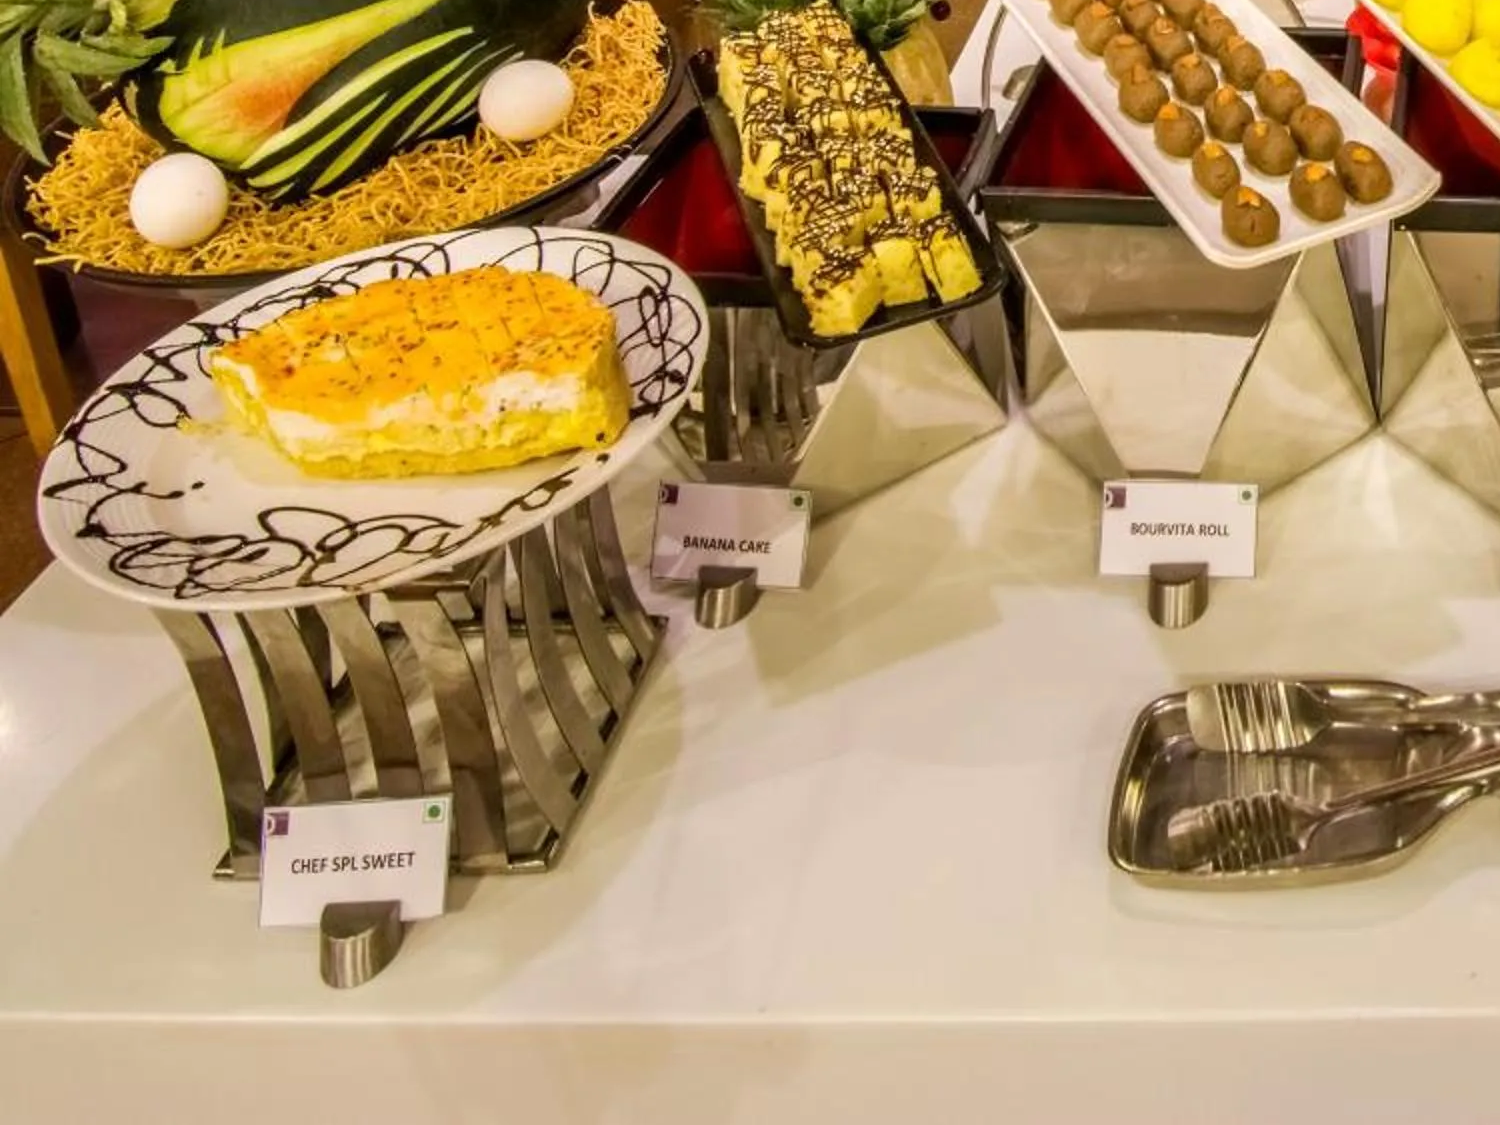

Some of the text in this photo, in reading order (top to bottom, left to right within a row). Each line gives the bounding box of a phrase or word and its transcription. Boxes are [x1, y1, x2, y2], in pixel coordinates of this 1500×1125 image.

[1131, 523, 1230, 537] BOURVITA ROLL
[683, 536, 772, 554] BANANA CAKE
[291, 851, 416, 874] CHEF SPL SWEET
